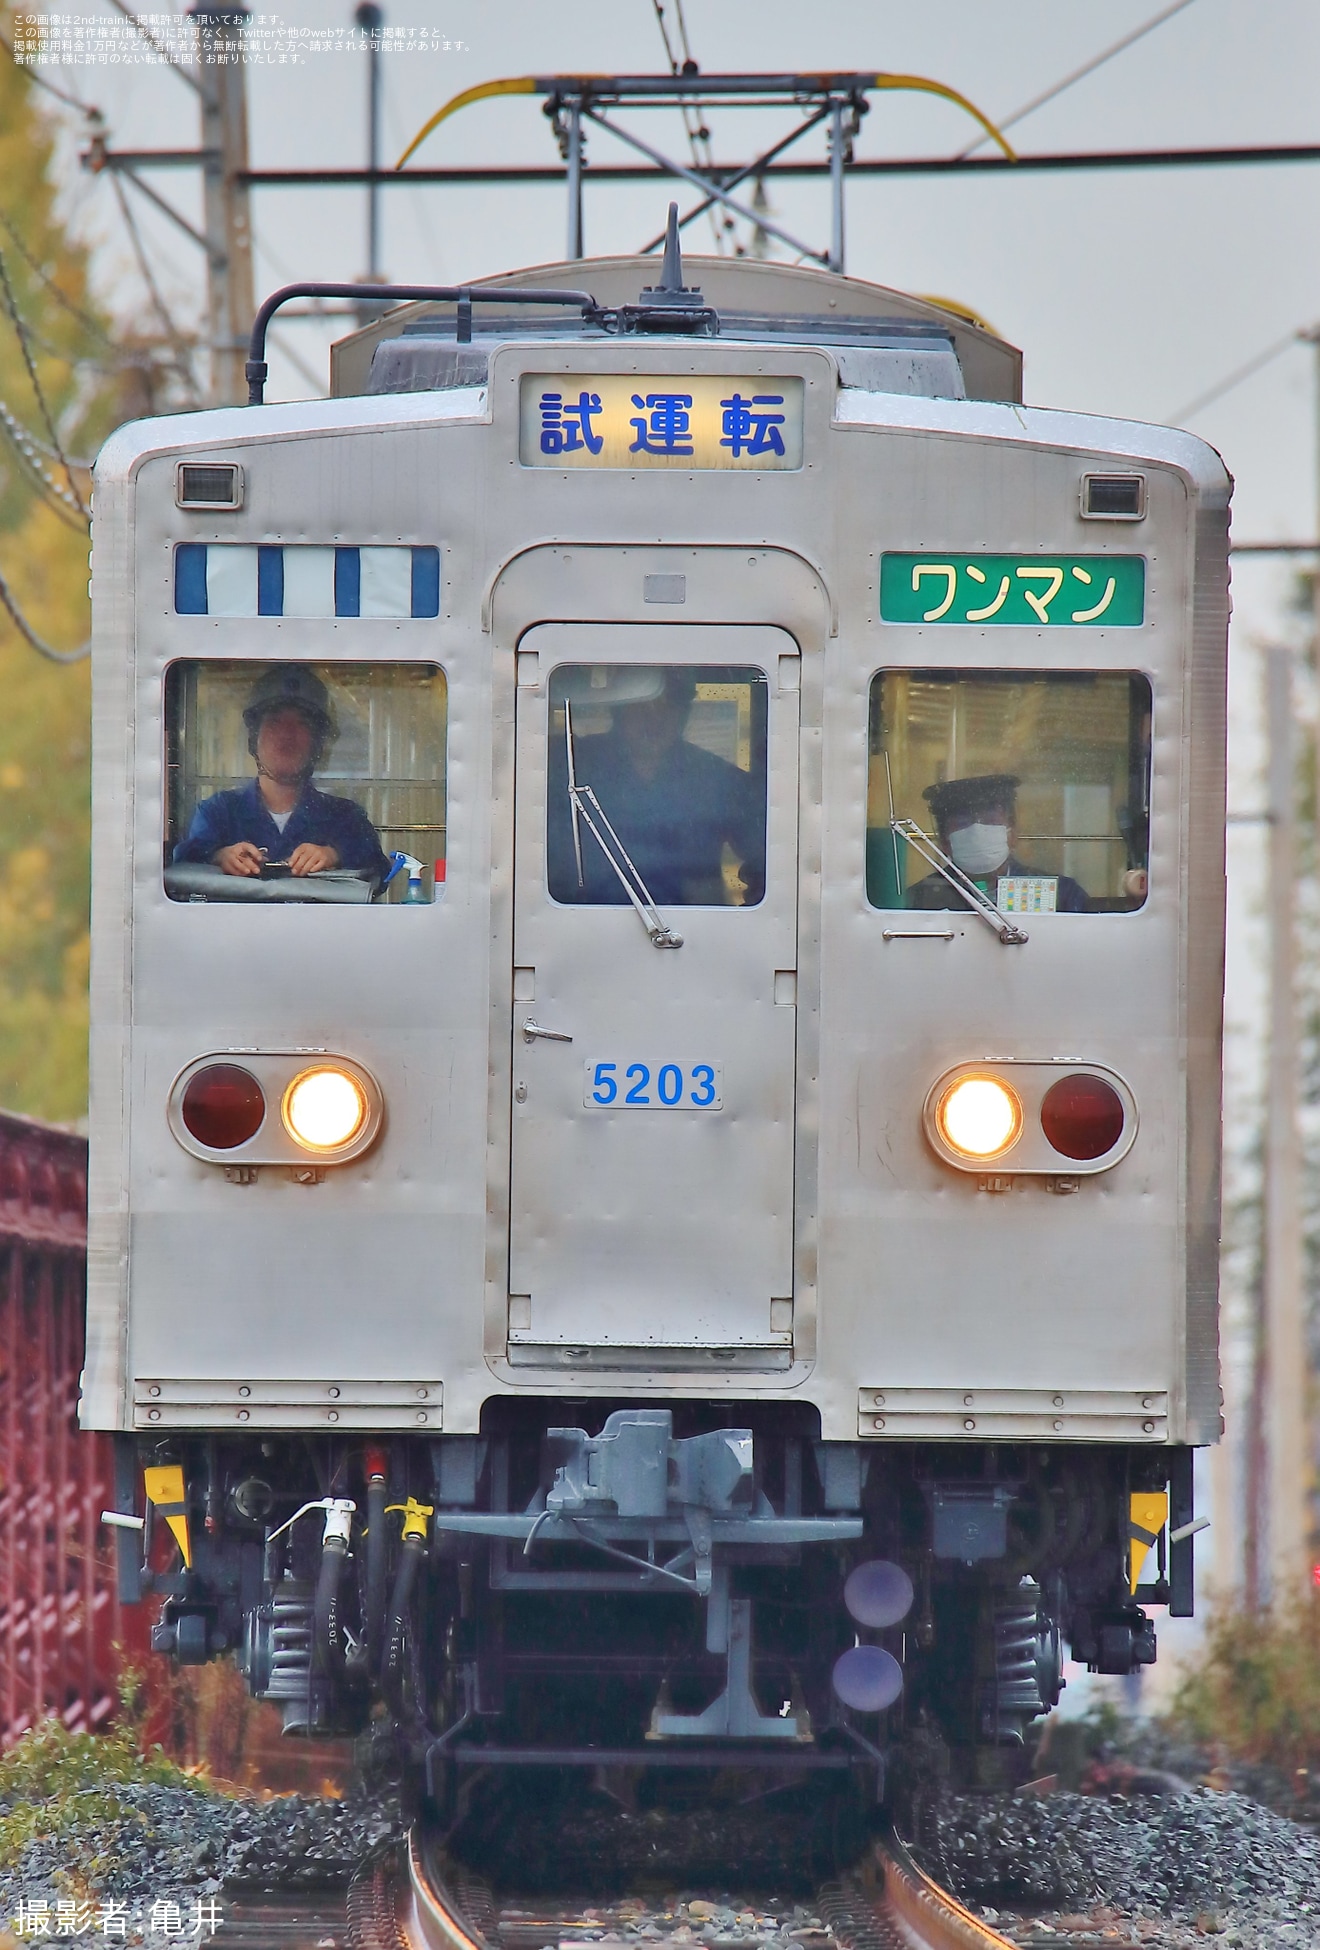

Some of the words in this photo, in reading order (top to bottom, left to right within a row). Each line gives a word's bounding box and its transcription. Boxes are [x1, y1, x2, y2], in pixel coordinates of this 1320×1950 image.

[539, 392, 785, 458] 試運転
[912, 564, 1116, 624] ワンマン
[593, 1063, 716, 1106] 5203
